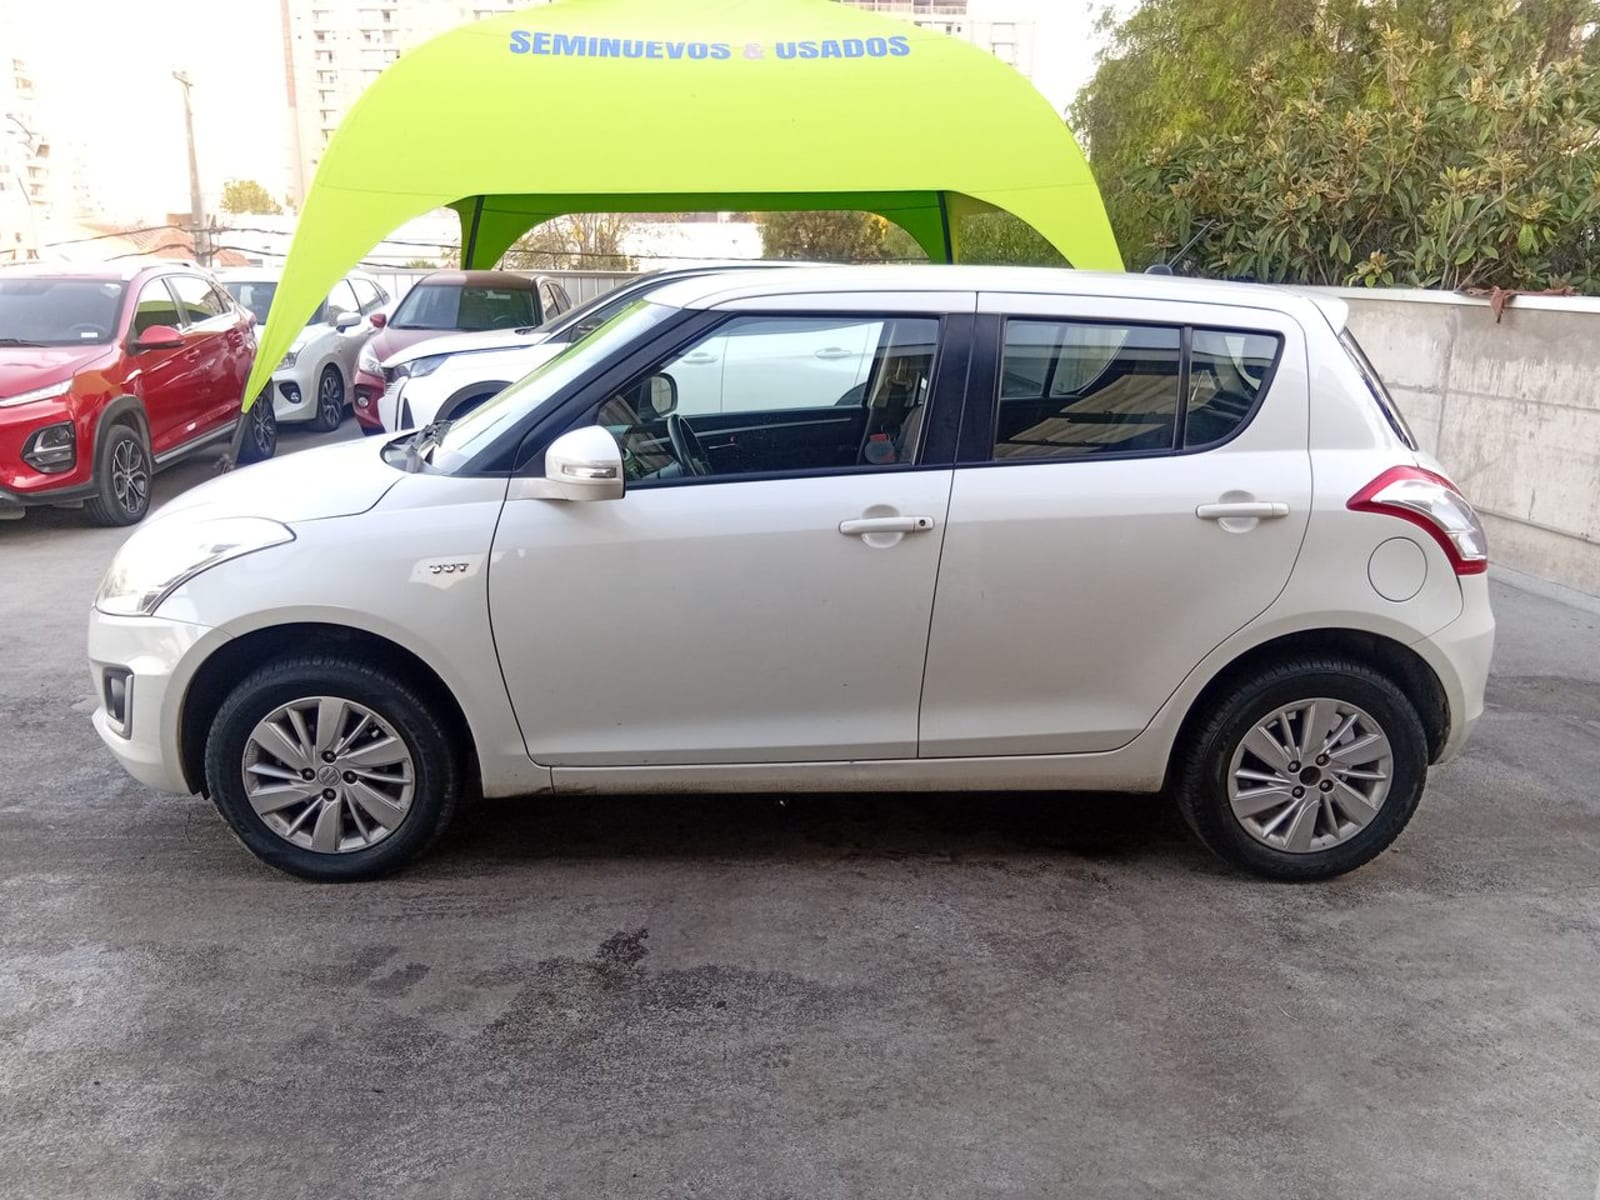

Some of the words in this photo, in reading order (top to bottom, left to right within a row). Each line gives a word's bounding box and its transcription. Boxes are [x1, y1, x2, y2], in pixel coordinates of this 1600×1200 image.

[509, 30, 731, 60] SEMINUEVOS
[743, 43, 765, 60] &
[775, 35, 910, 59] USADOS
